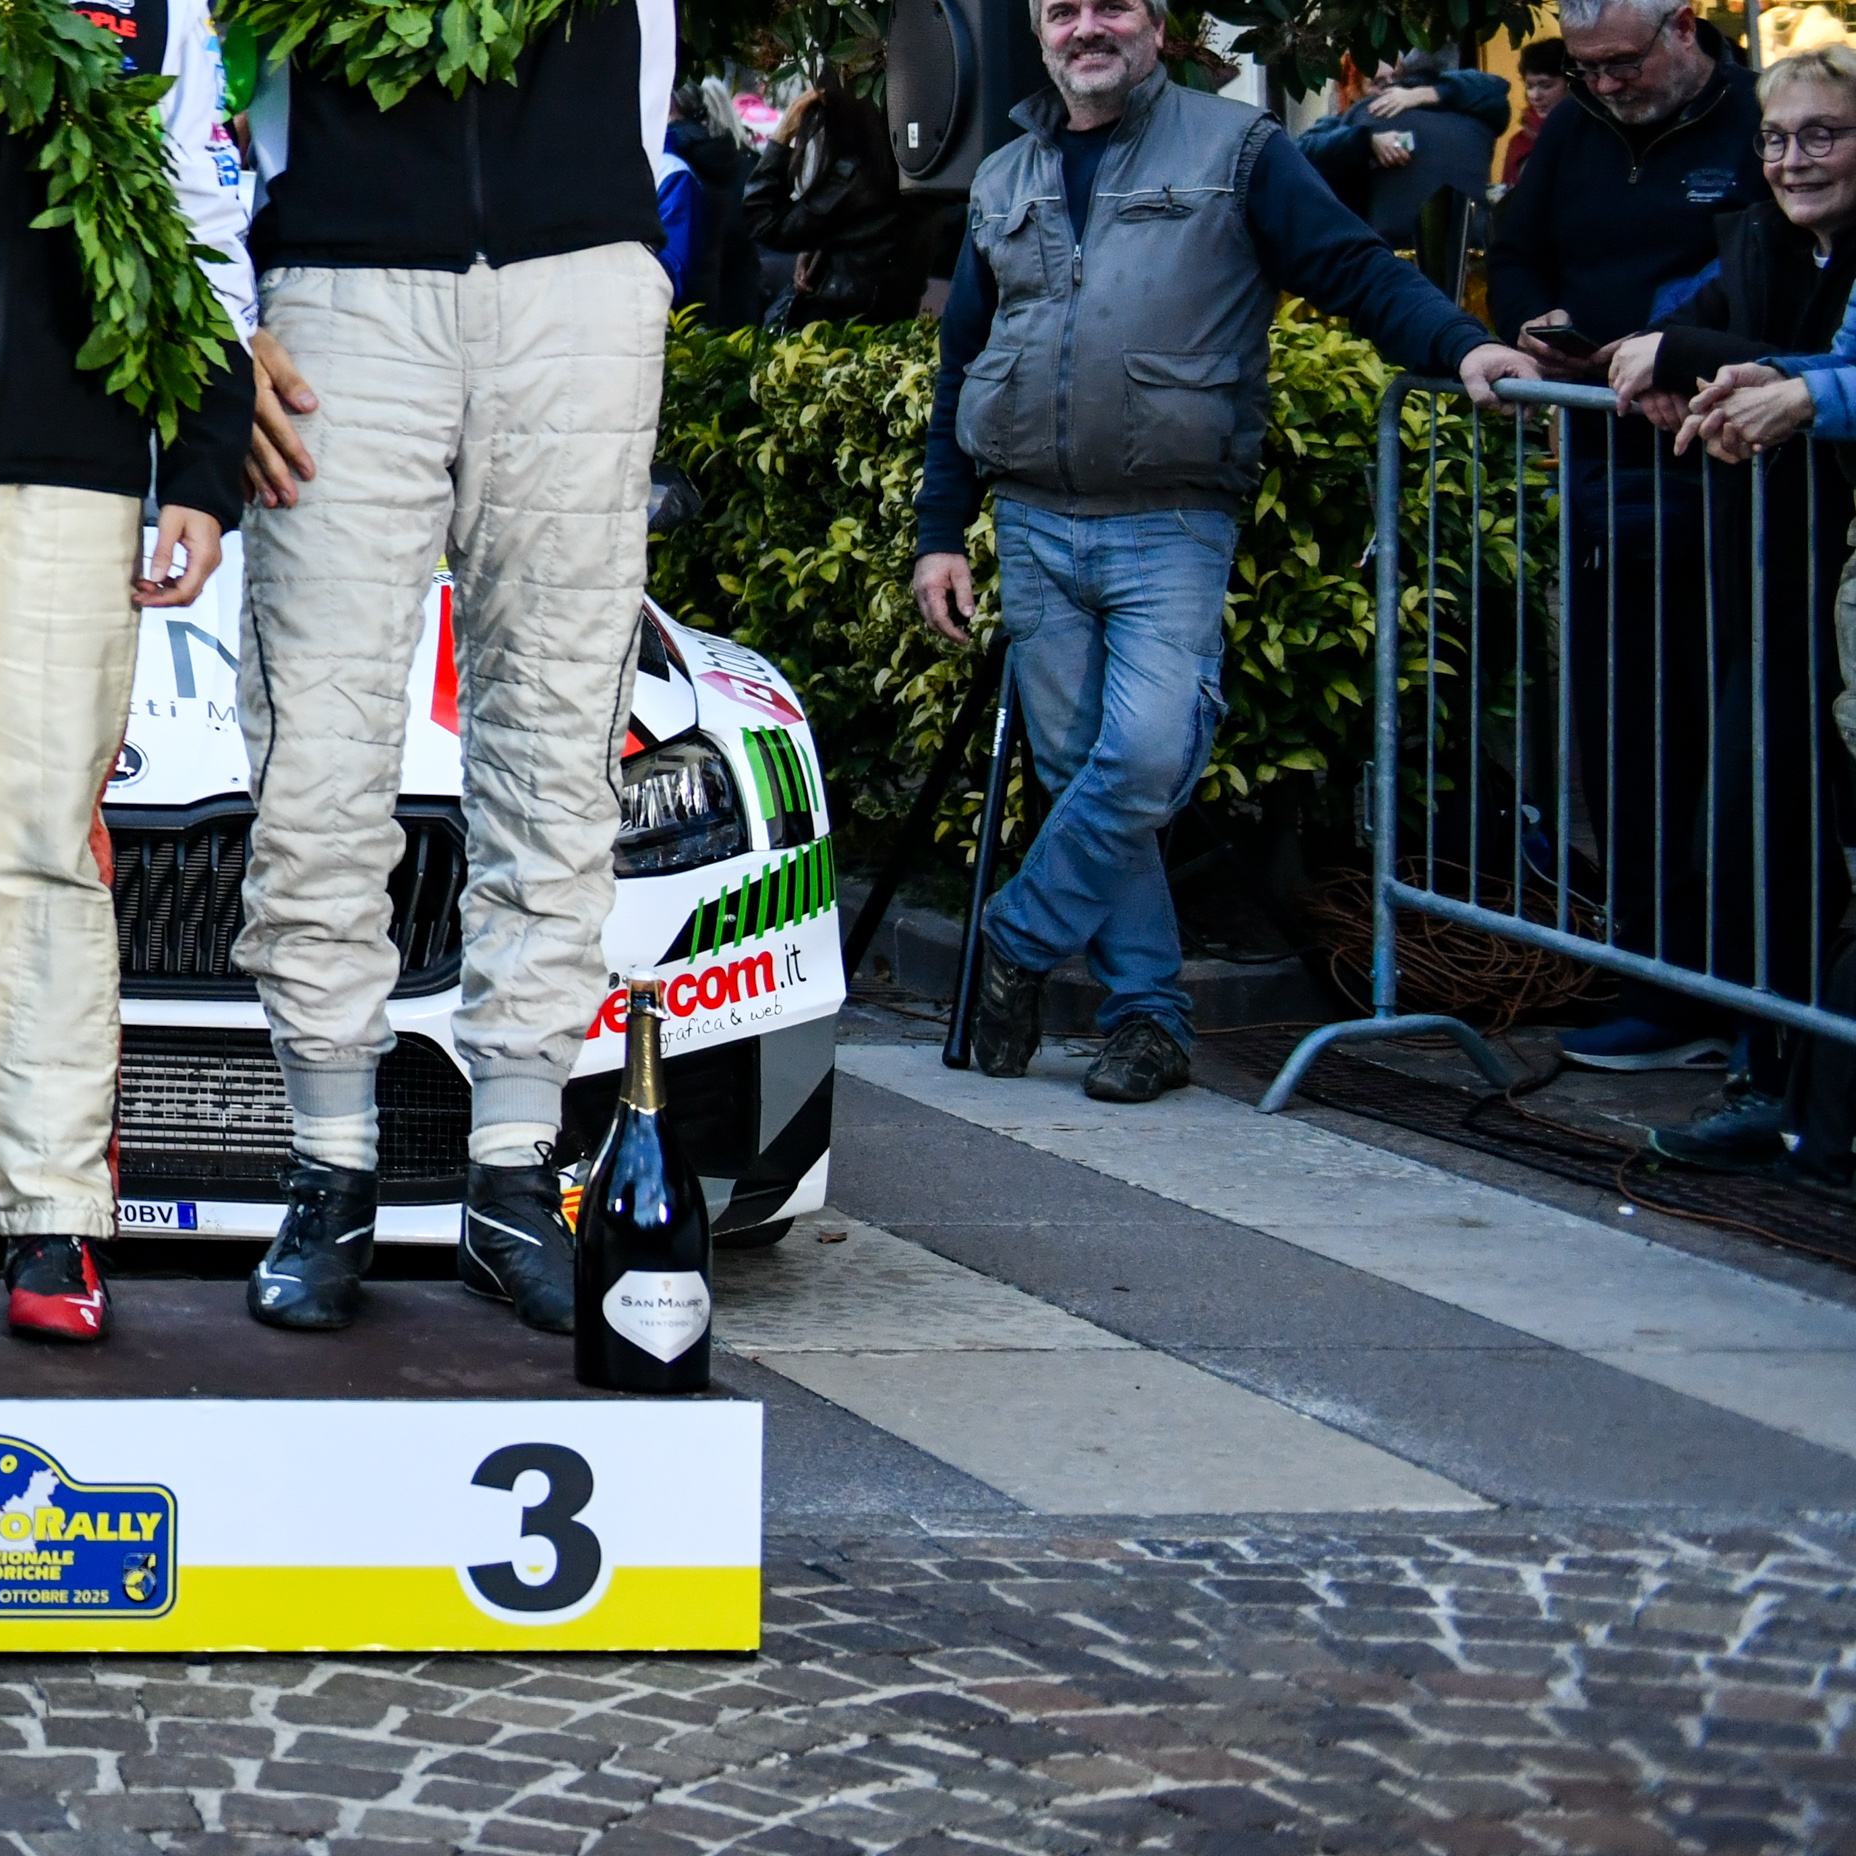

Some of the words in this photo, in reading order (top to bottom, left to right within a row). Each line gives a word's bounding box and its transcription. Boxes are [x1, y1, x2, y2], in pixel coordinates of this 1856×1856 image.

[660, 1016, 725, 1056] grafica
[730, 1007, 744, 1026] &
[750, 995, 783, 1019] web
[620, 1295, 654, 1308] SAN
[658, 1298, 703, 1309] MAURO
[469, 1442, 603, 1613] 3
[73, 1590, 110, 1604] 2025
